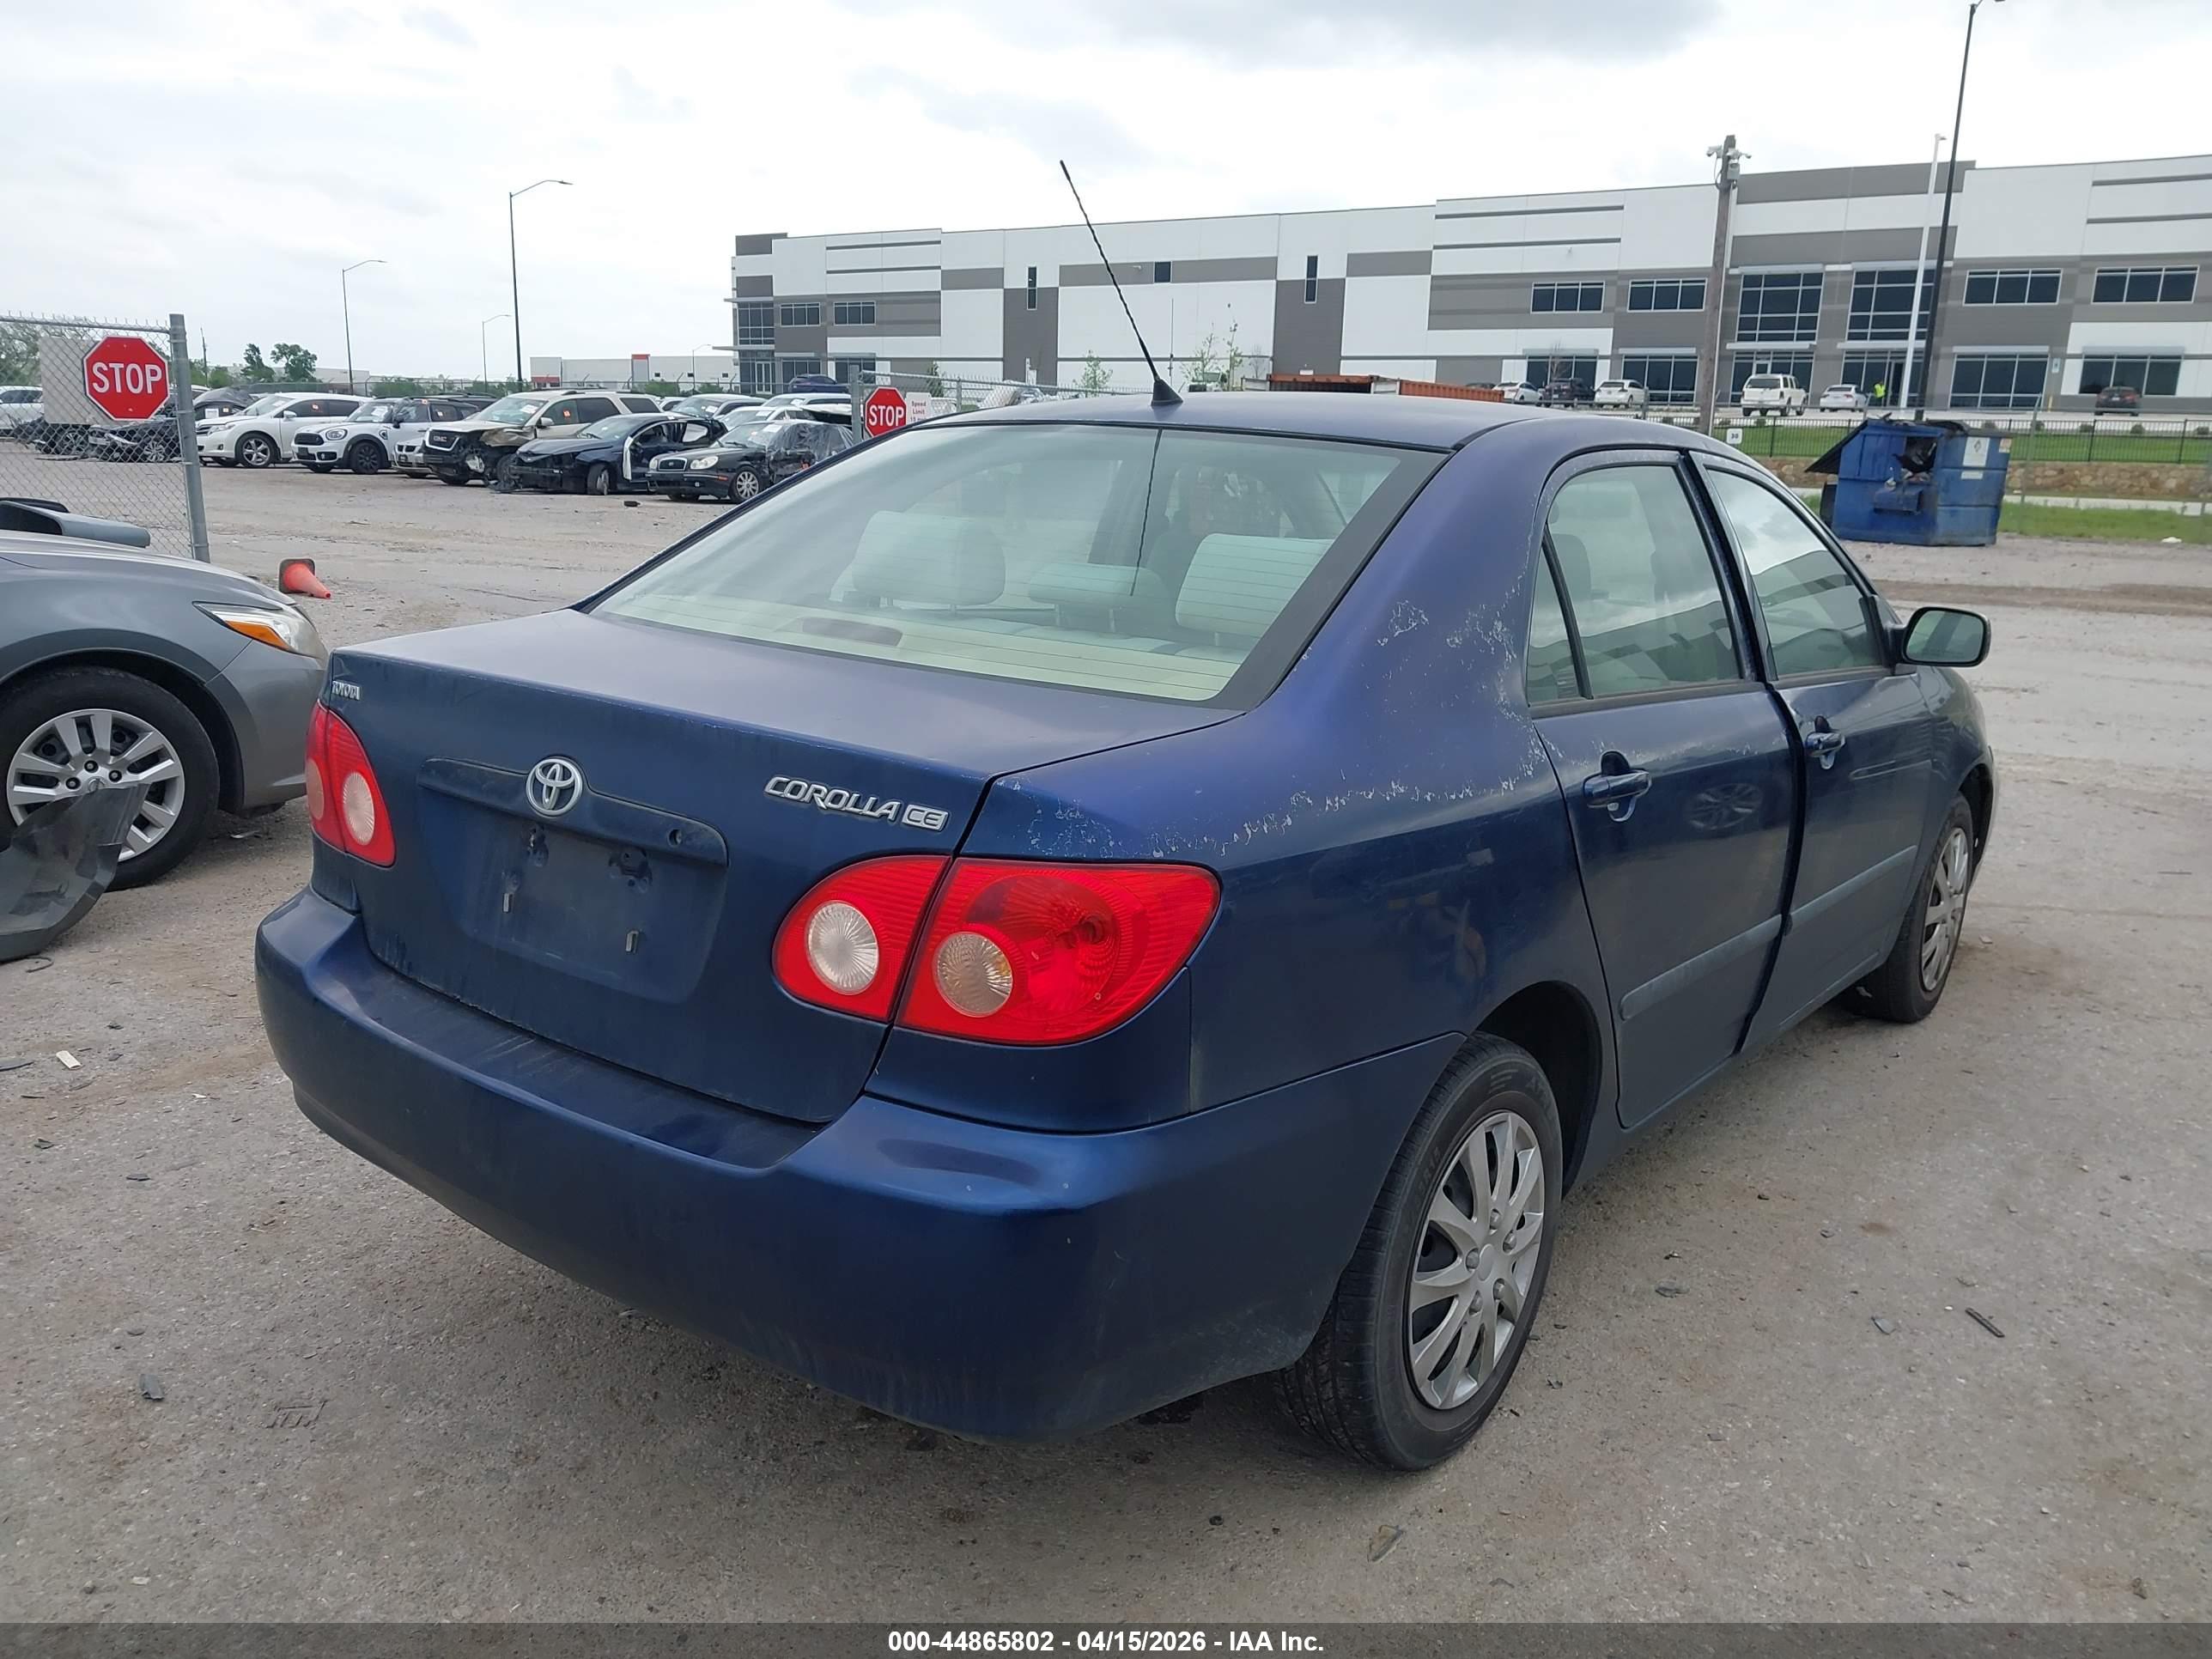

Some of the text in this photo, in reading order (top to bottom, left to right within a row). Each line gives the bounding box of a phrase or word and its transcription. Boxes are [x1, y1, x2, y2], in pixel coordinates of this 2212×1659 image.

[92, 362, 162, 393] STOP
[868, 404, 904, 427] STOP
[764, 776, 946, 830] COROLLA CE
